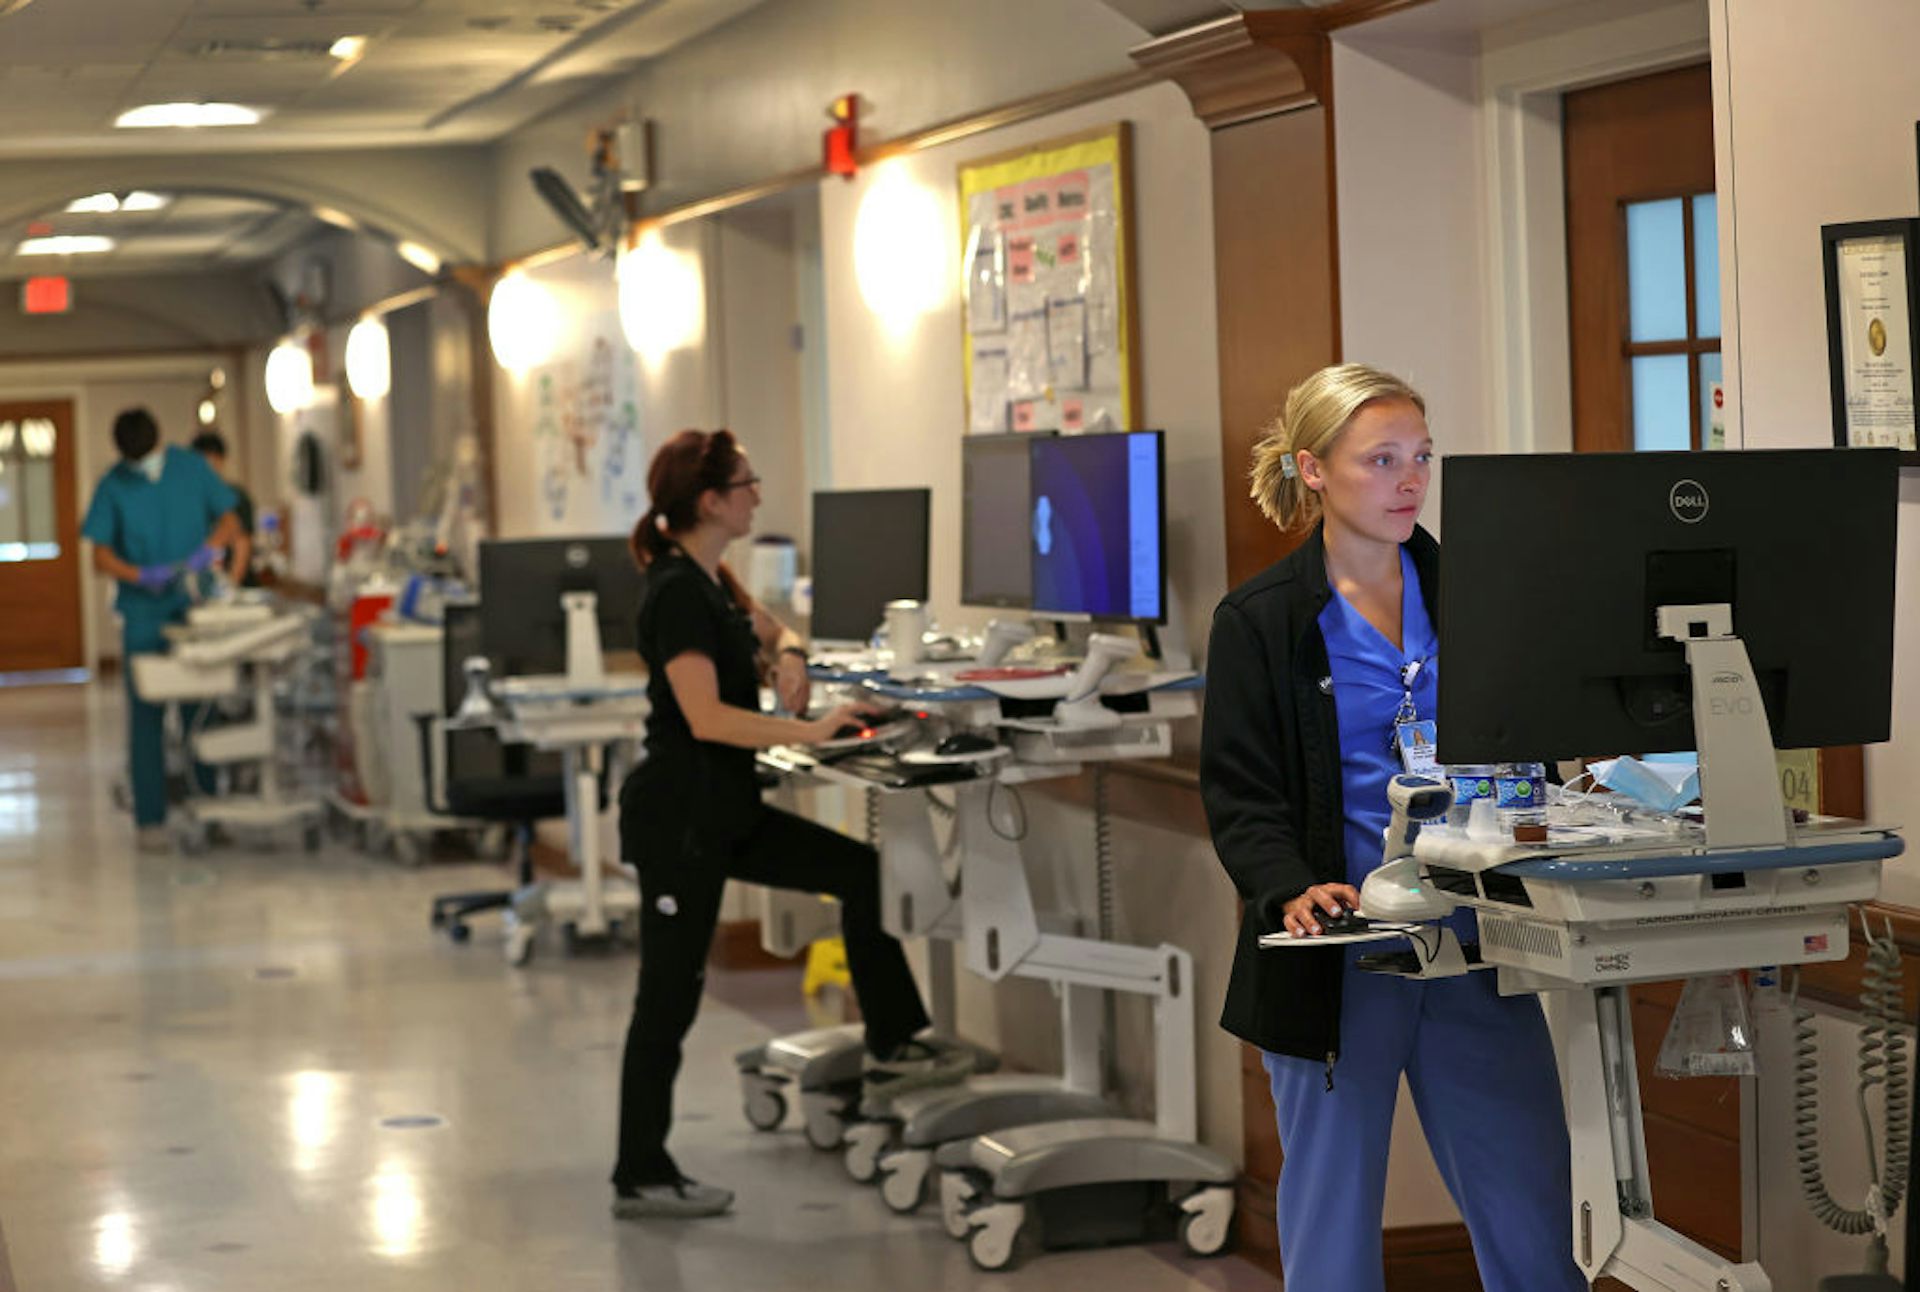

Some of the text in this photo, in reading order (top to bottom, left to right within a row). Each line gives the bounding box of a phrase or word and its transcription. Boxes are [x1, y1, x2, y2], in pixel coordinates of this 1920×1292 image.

[1674, 495, 1706, 508] DELL
[1710, 697, 1753, 716] EVO
[1636, 905, 1807, 926] CARDIOMYOPATHY CENTER
